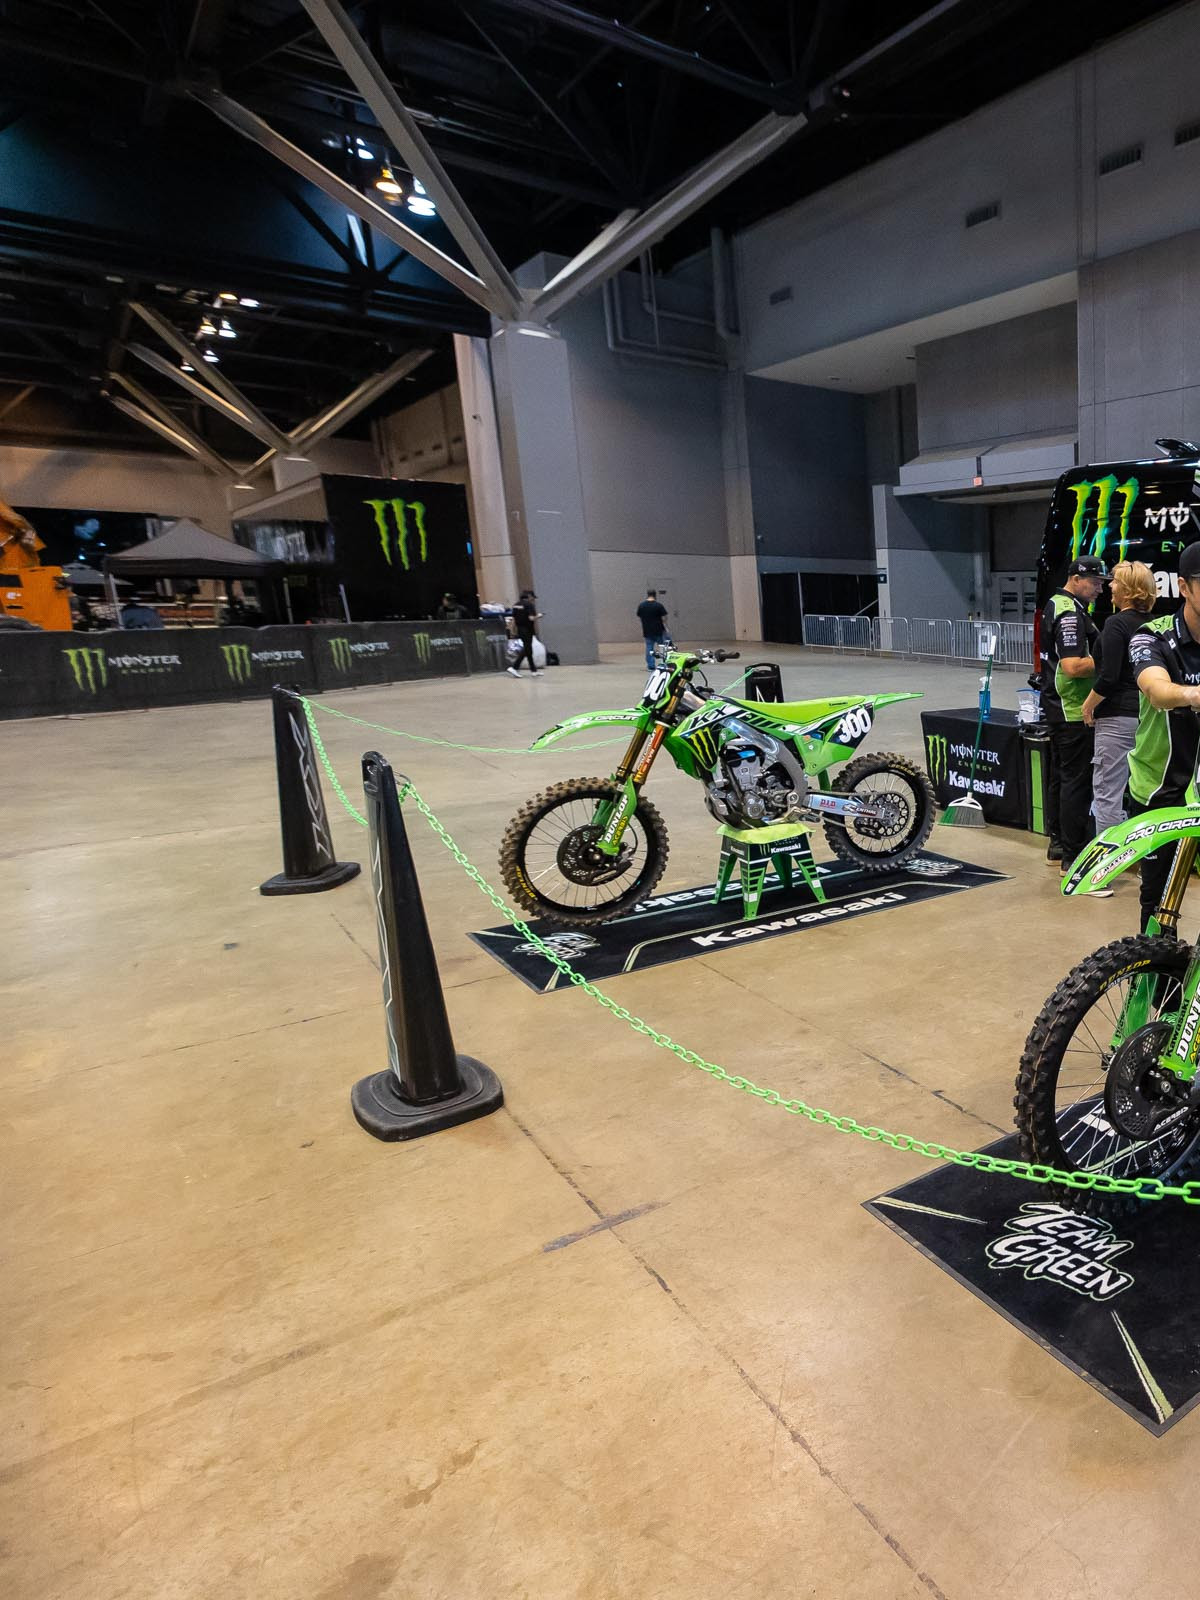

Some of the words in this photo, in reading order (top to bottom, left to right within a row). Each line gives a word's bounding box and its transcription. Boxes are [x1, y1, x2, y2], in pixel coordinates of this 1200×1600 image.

[108, 654, 183, 668] MONSTER
[251, 650, 305, 661] MONSTER
[838, 708, 872, 743] 300
[604, 795, 629, 844] DUNLOP
[1125, 825, 1155, 845] PRO
[690, 892, 907, 947] Kawasaki
[1012, 1204, 1128, 1260] TEAM
[993, 1234, 1128, 1295] GREEN
